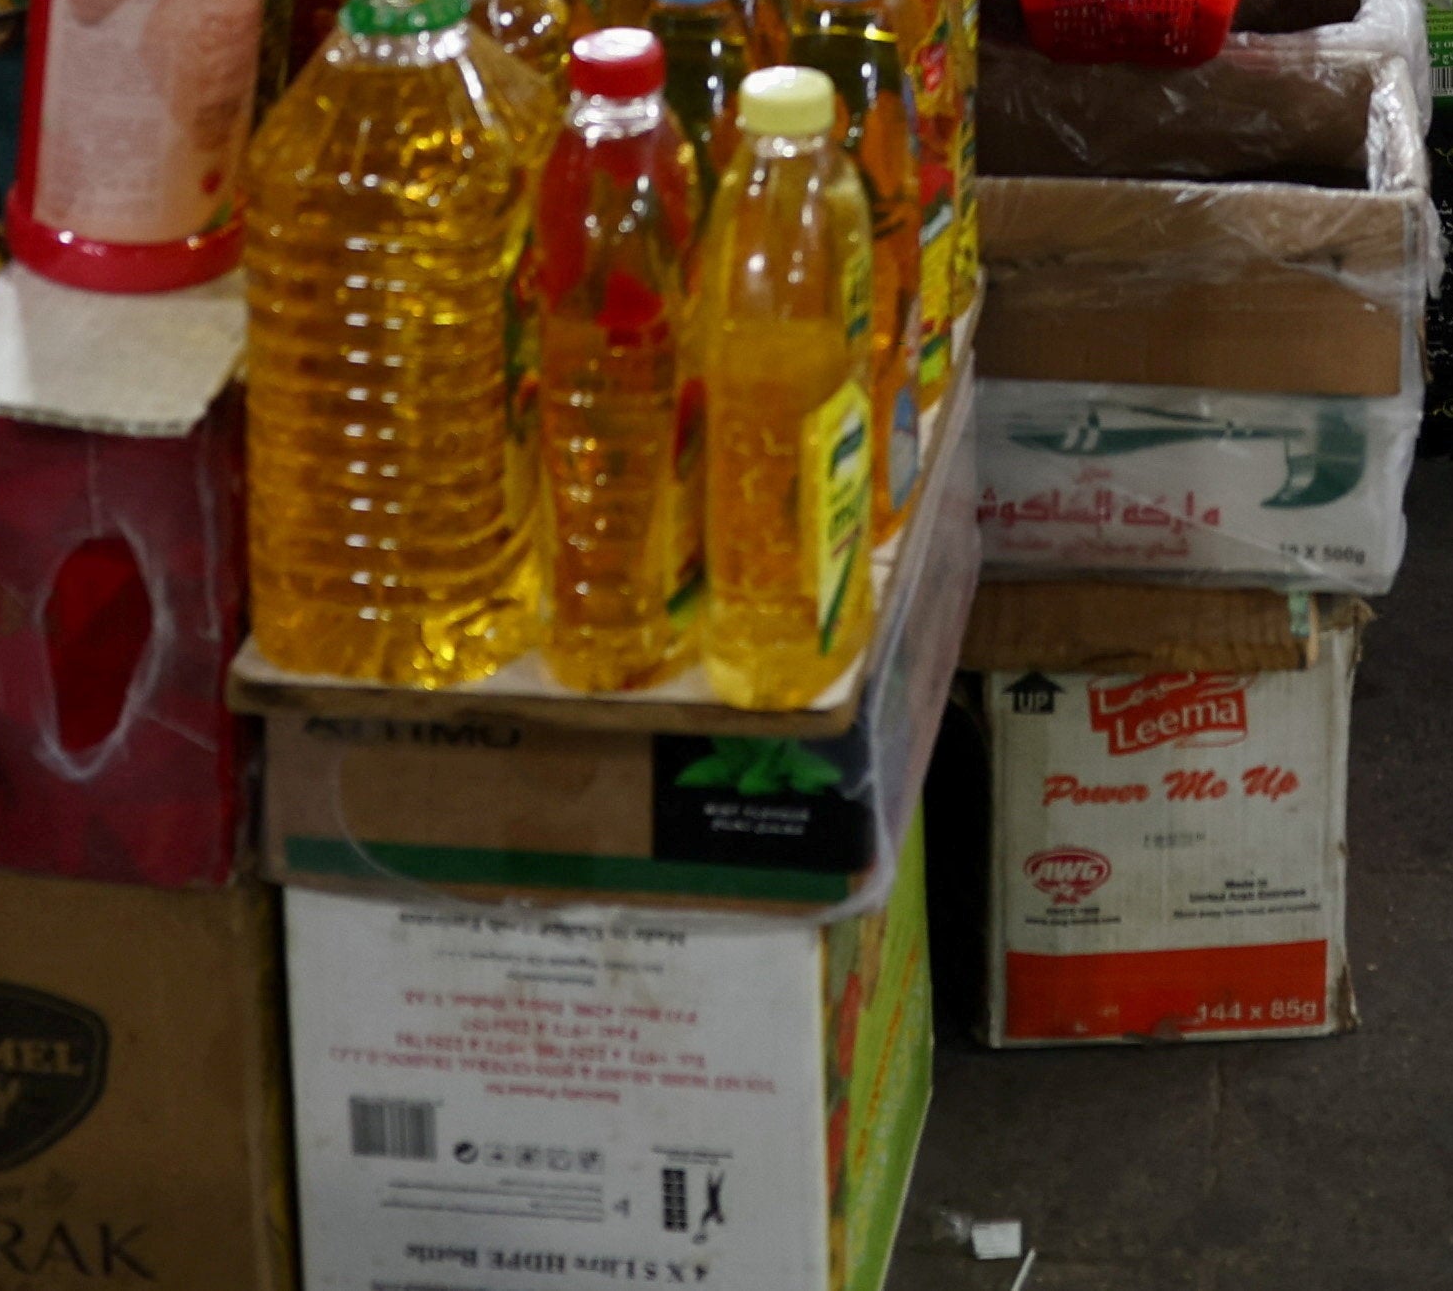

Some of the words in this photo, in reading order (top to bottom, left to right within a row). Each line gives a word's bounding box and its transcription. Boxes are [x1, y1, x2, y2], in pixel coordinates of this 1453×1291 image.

[1114, 696, 1239, 751] Leema
[1041, 774, 1151, 808] Power
[1242, 766, 1300, 803] Up
[1270, 999, 1317, 1023] 85g
[404, 1243, 478, 1269] Bottle
[487, 1249, 566, 1275] HDPE
[572, 1253, 638, 1280] Litre
